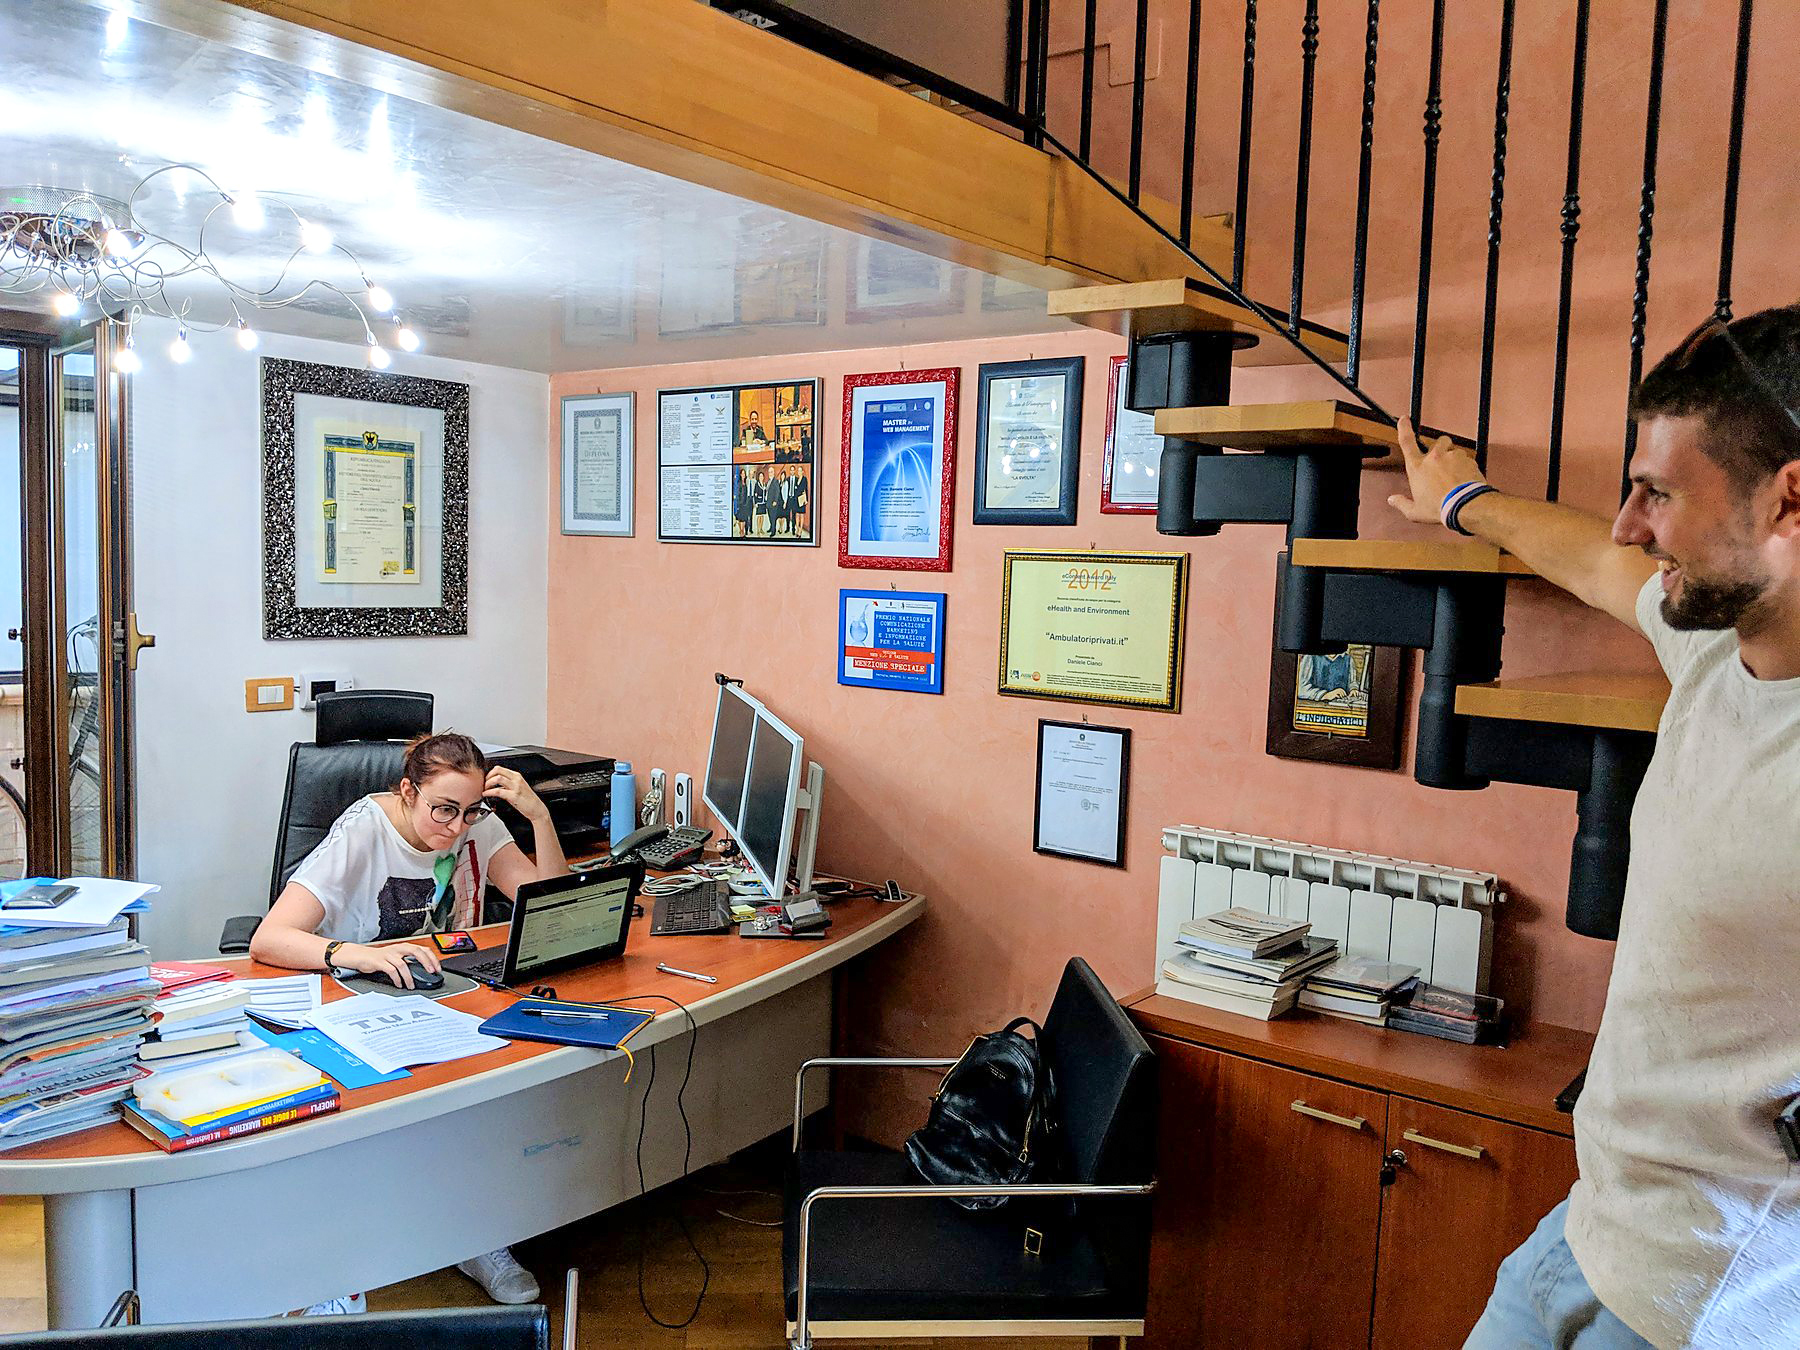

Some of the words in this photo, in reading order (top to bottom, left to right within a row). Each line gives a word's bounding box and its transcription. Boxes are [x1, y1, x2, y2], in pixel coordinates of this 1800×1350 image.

[894, 425, 930, 433] MANAGEMENT
[1068, 568, 1112, 590] 2012
[1047, 604, 1072, 612] eHealth
[1087, 606, 1130, 616] Environment
[898, 615, 931, 623] NAZIONALE
[879, 620, 926, 629] COMUNICAZIONE
[886, 627, 918, 635] MARKETING
[885, 633, 927, 641] INFORMAZIONE
[903, 640, 925, 648] SALUTE
[854, 659, 889, 669] MENZIONE
[890, 662, 925, 672] SPECIALE
[248, 1096, 295, 1116] NEUROMARKETING
[310, 1099, 335, 1113] HOEPLI
[272, 1111, 290, 1124] BUGIE
[290, 1109, 297, 1118] LE
[261, 1116, 272, 1126] DEL
[229, 1119, 261, 1135] MARKETING
[186, 1133, 214, 1145] Lindstrom
[214, 1131, 221, 1139] M.
